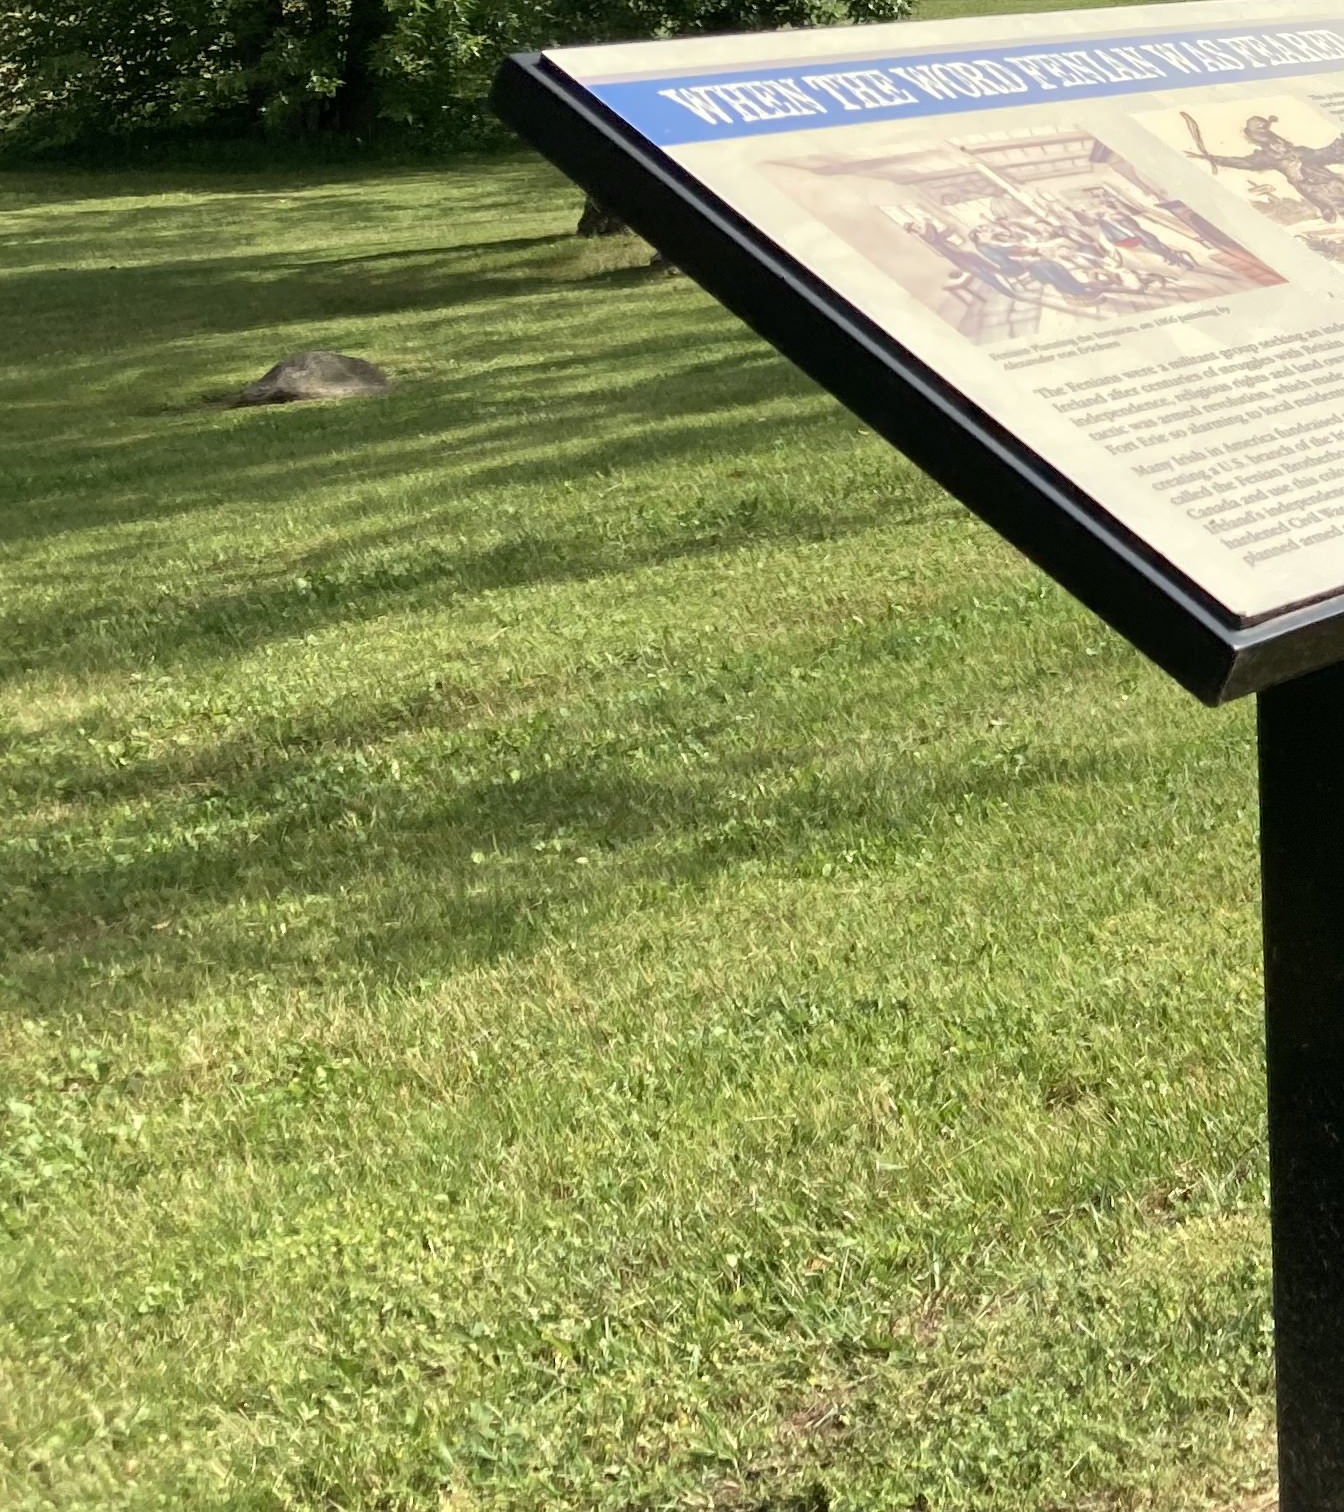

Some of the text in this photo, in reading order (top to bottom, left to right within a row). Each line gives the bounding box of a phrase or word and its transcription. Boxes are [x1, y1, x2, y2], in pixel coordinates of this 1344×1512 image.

[660, 79, 825, 124] WHEN
[803, 70, 917, 110] THE
[890, 60, 1027, 99] WORD
[1006, 47, 1165, 89] FENIAN
[1142, 40, 1244, 73] WAS
[1033, 386, 1068, 399] The
[1064, 374, 1123, 393] Fenians
[1121, 366, 1158, 379] were
[1168, 352, 1220, 370] militant
[1219, 343, 1259, 360] group
[1258, 333, 1309, 349] seeking
[1052, 392, 1108, 413] Ireland
[1107, 387, 1140, 401] after
[1141, 373, 1203, 393] centuries
[1218, 356, 1276, 375] struggles
[1273, 348, 1305, 361] with
[1300, 340, 1344, 355] Britain
[1070, 398, 1176, 427] independence,
[1232, 374, 1270, 389] rights
[1269, 365, 1296, 380] and
[1291, 358, 1325, 374] land
[1088, 425, 1130, 441] tactic
[1128, 418, 1158, 431] was
[1157, 404, 1203, 425] armed
[1202, 391, 1275, 413] revolution,
[1272, 379, 1313, 395] which
[1104, 441, 1140, 456] Fort
[1136, 434, 1170, 447] Erie
[1187, 414, 1250, 435] alarming
[1258, 399, 1295, 416] local
[1131, 460, 1174, 477] Many
[1170, 450, 1208, 466] Irish
[1222, 433, 1279, 453] America
[1274, 413, 1344, 439] fundraised
[1152, 470, 1213, 491] creating
[1244, 445, 1296, 465] branch
[1309, 436, 1334, 448] the
[1170, 485, 1214, 506] called
[1211, 481, 1238, 494] the
[1234, 468, 1284, 487] Fenian
[1186, 498, 1242, 520] Canada
[1240, 488, 1270, 505] and
[1266, 484, 1294, 497] use
[1292, 476, 1320, 490] this
[1220, 521, 1291, 550] hardened
[1287, 511, 1323, 529] Civil
[1243, 538, 1301, 568] planned
[1299, 524, 1344, 547] armed
